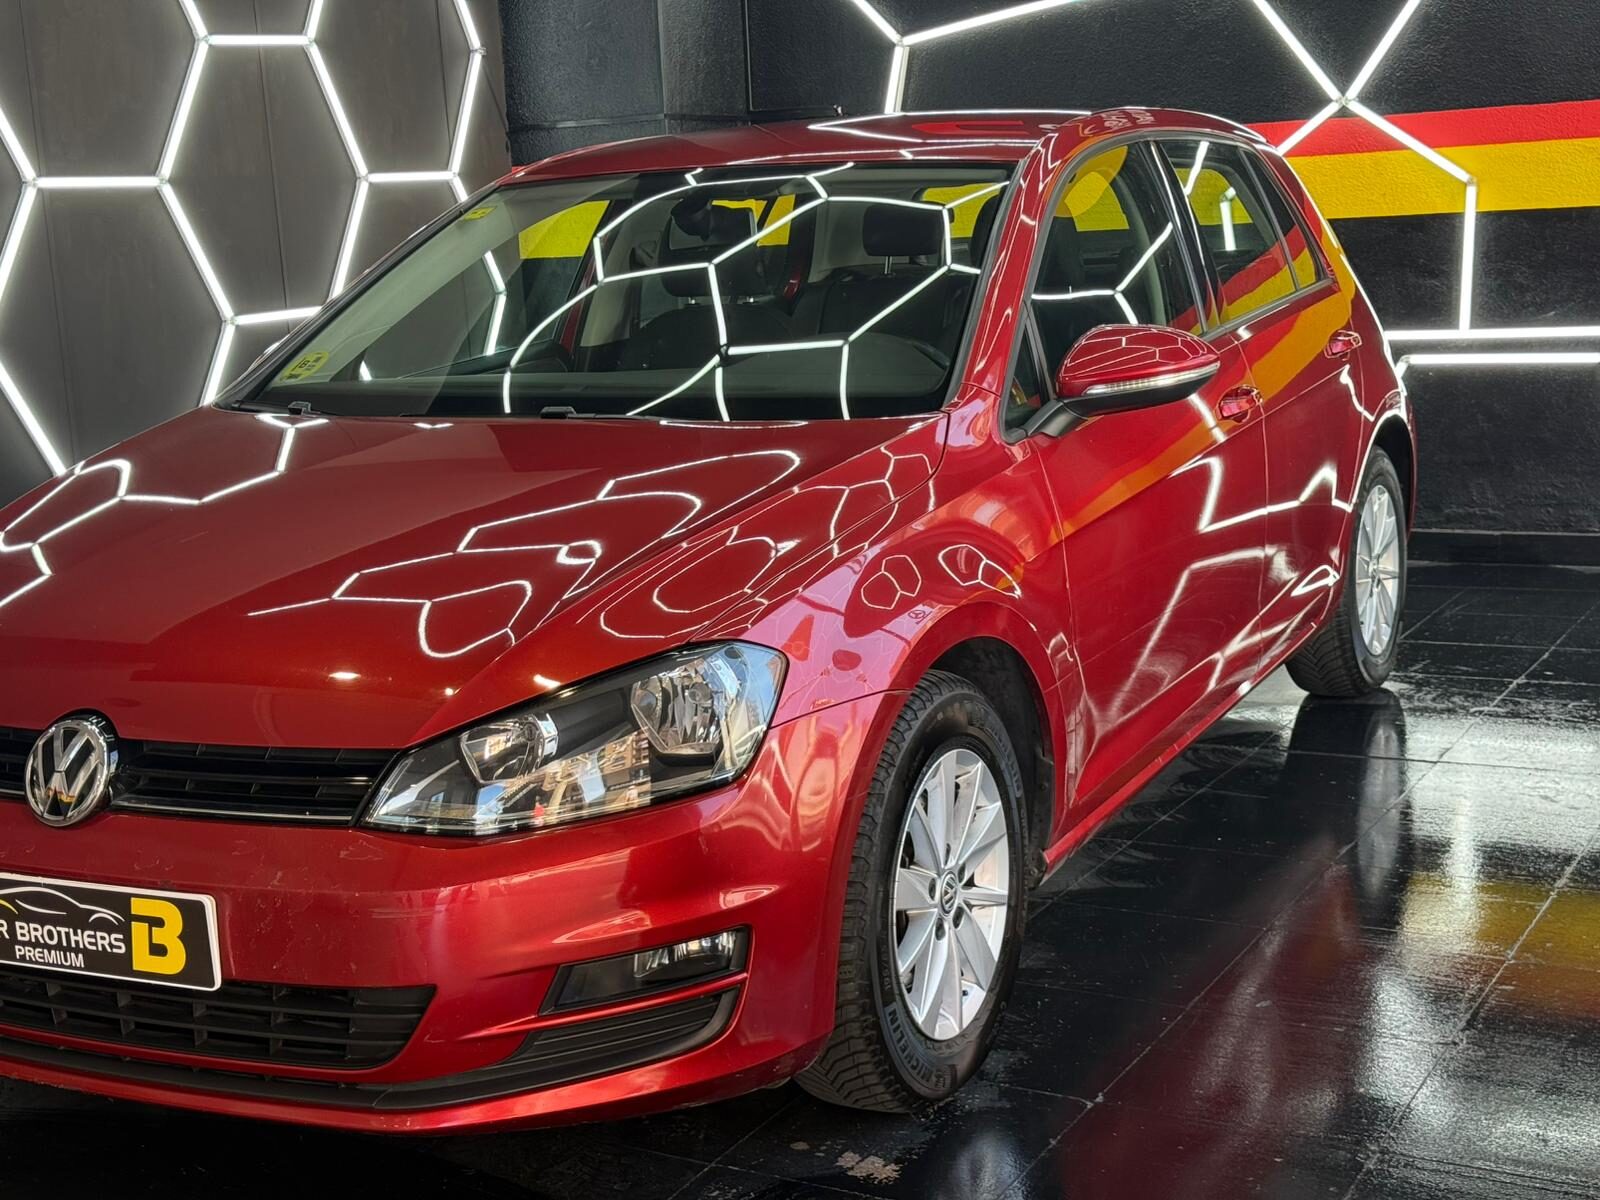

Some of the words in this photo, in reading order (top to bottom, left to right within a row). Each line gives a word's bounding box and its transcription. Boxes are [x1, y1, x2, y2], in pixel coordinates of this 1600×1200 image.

[15, 921, 126, 954] BROTHERS
[15, 945, 85, 968] PREMIUM
[888, 1008, 934, 1083] MICHELIN
